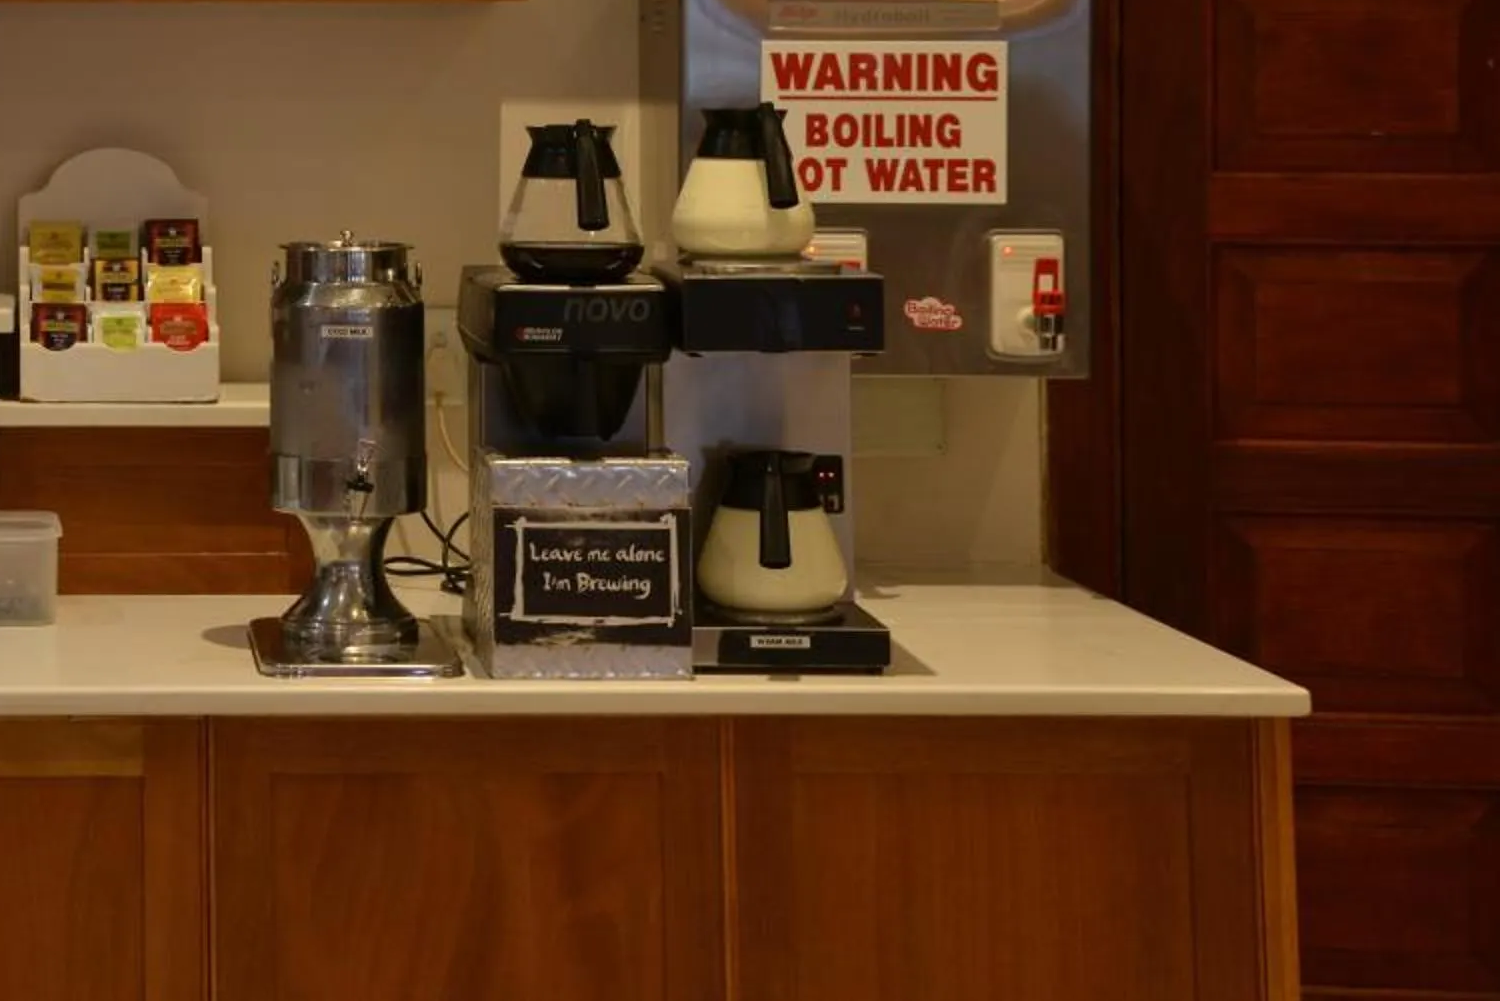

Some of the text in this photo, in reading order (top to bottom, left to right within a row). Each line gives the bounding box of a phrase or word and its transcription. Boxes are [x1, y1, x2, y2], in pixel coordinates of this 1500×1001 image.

[770, 52, 999, 92] WARNING
[805, 113, 962, 148] BOILING
[797, 157, 997, 193] OT WATER
[563, 296, 651, 323] novo
[528, 541, 666, 563] Leave me alone
[542, 570, 652, 600] I'm Brewing
